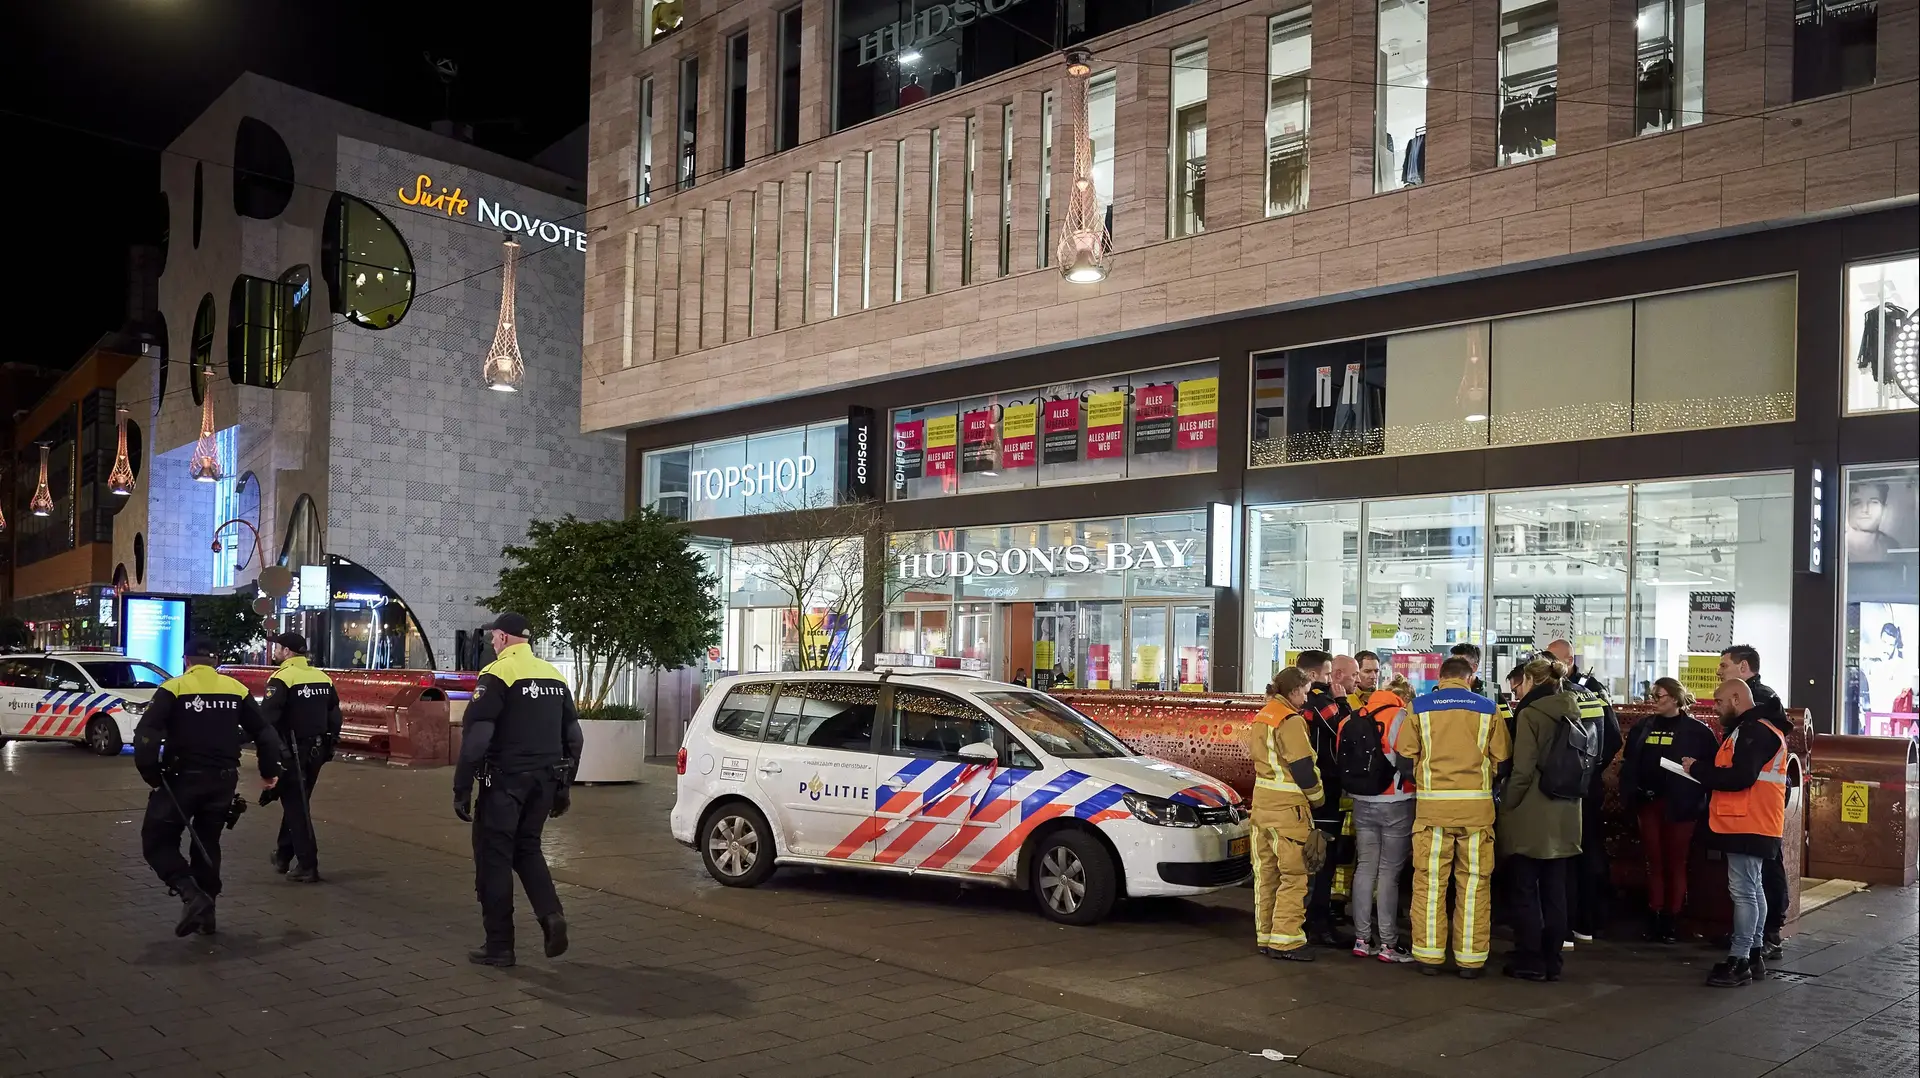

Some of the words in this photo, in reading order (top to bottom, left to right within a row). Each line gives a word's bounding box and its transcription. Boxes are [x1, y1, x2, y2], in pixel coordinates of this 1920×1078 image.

[399, 175, 468, 216] Suite
[478, 198, 588, 252] NOVOTE
[1145, 395, 1163, 406] ALLES
[1053, 409, 1069, 418] ALLES
[971, 420, 986, 429] ALLES
[1179, 421, 1197, 431] ALLES
[1198, 419, 1215, 429] MOET
[1088, 432, 1104, 442] ALLES
[1106, 431, 1121, 440] MOET
[1190, 430, 1204, 440] WEG
[1004, 443, 1019, 452] ALLES
[1020, 442, 1033, 450] MOET
[1098, 442, 1110, 451] WEG
[857, 425, 867, 484] TOPSHOP
[928, 452, 941, 461] ALLES
[942, 451, 954, 460] MOET
[1013, 452, 1024, 461] WEG
[936, 461, 945, 470] WEG
[692, 455, 816, 501] TOPSHOP
[898, 544, 1091, 579] HUDSON'S
[1105, 538, 1195, 571] BAY
[298, 686, 329, 698] POLITIE
[522, 681, 564, 698] POLITIE
[8, 700, 34, 710] POLITIE
[185, 696, 237, 712] POLITIE
[800, 776, 869, 801] POLITIE
